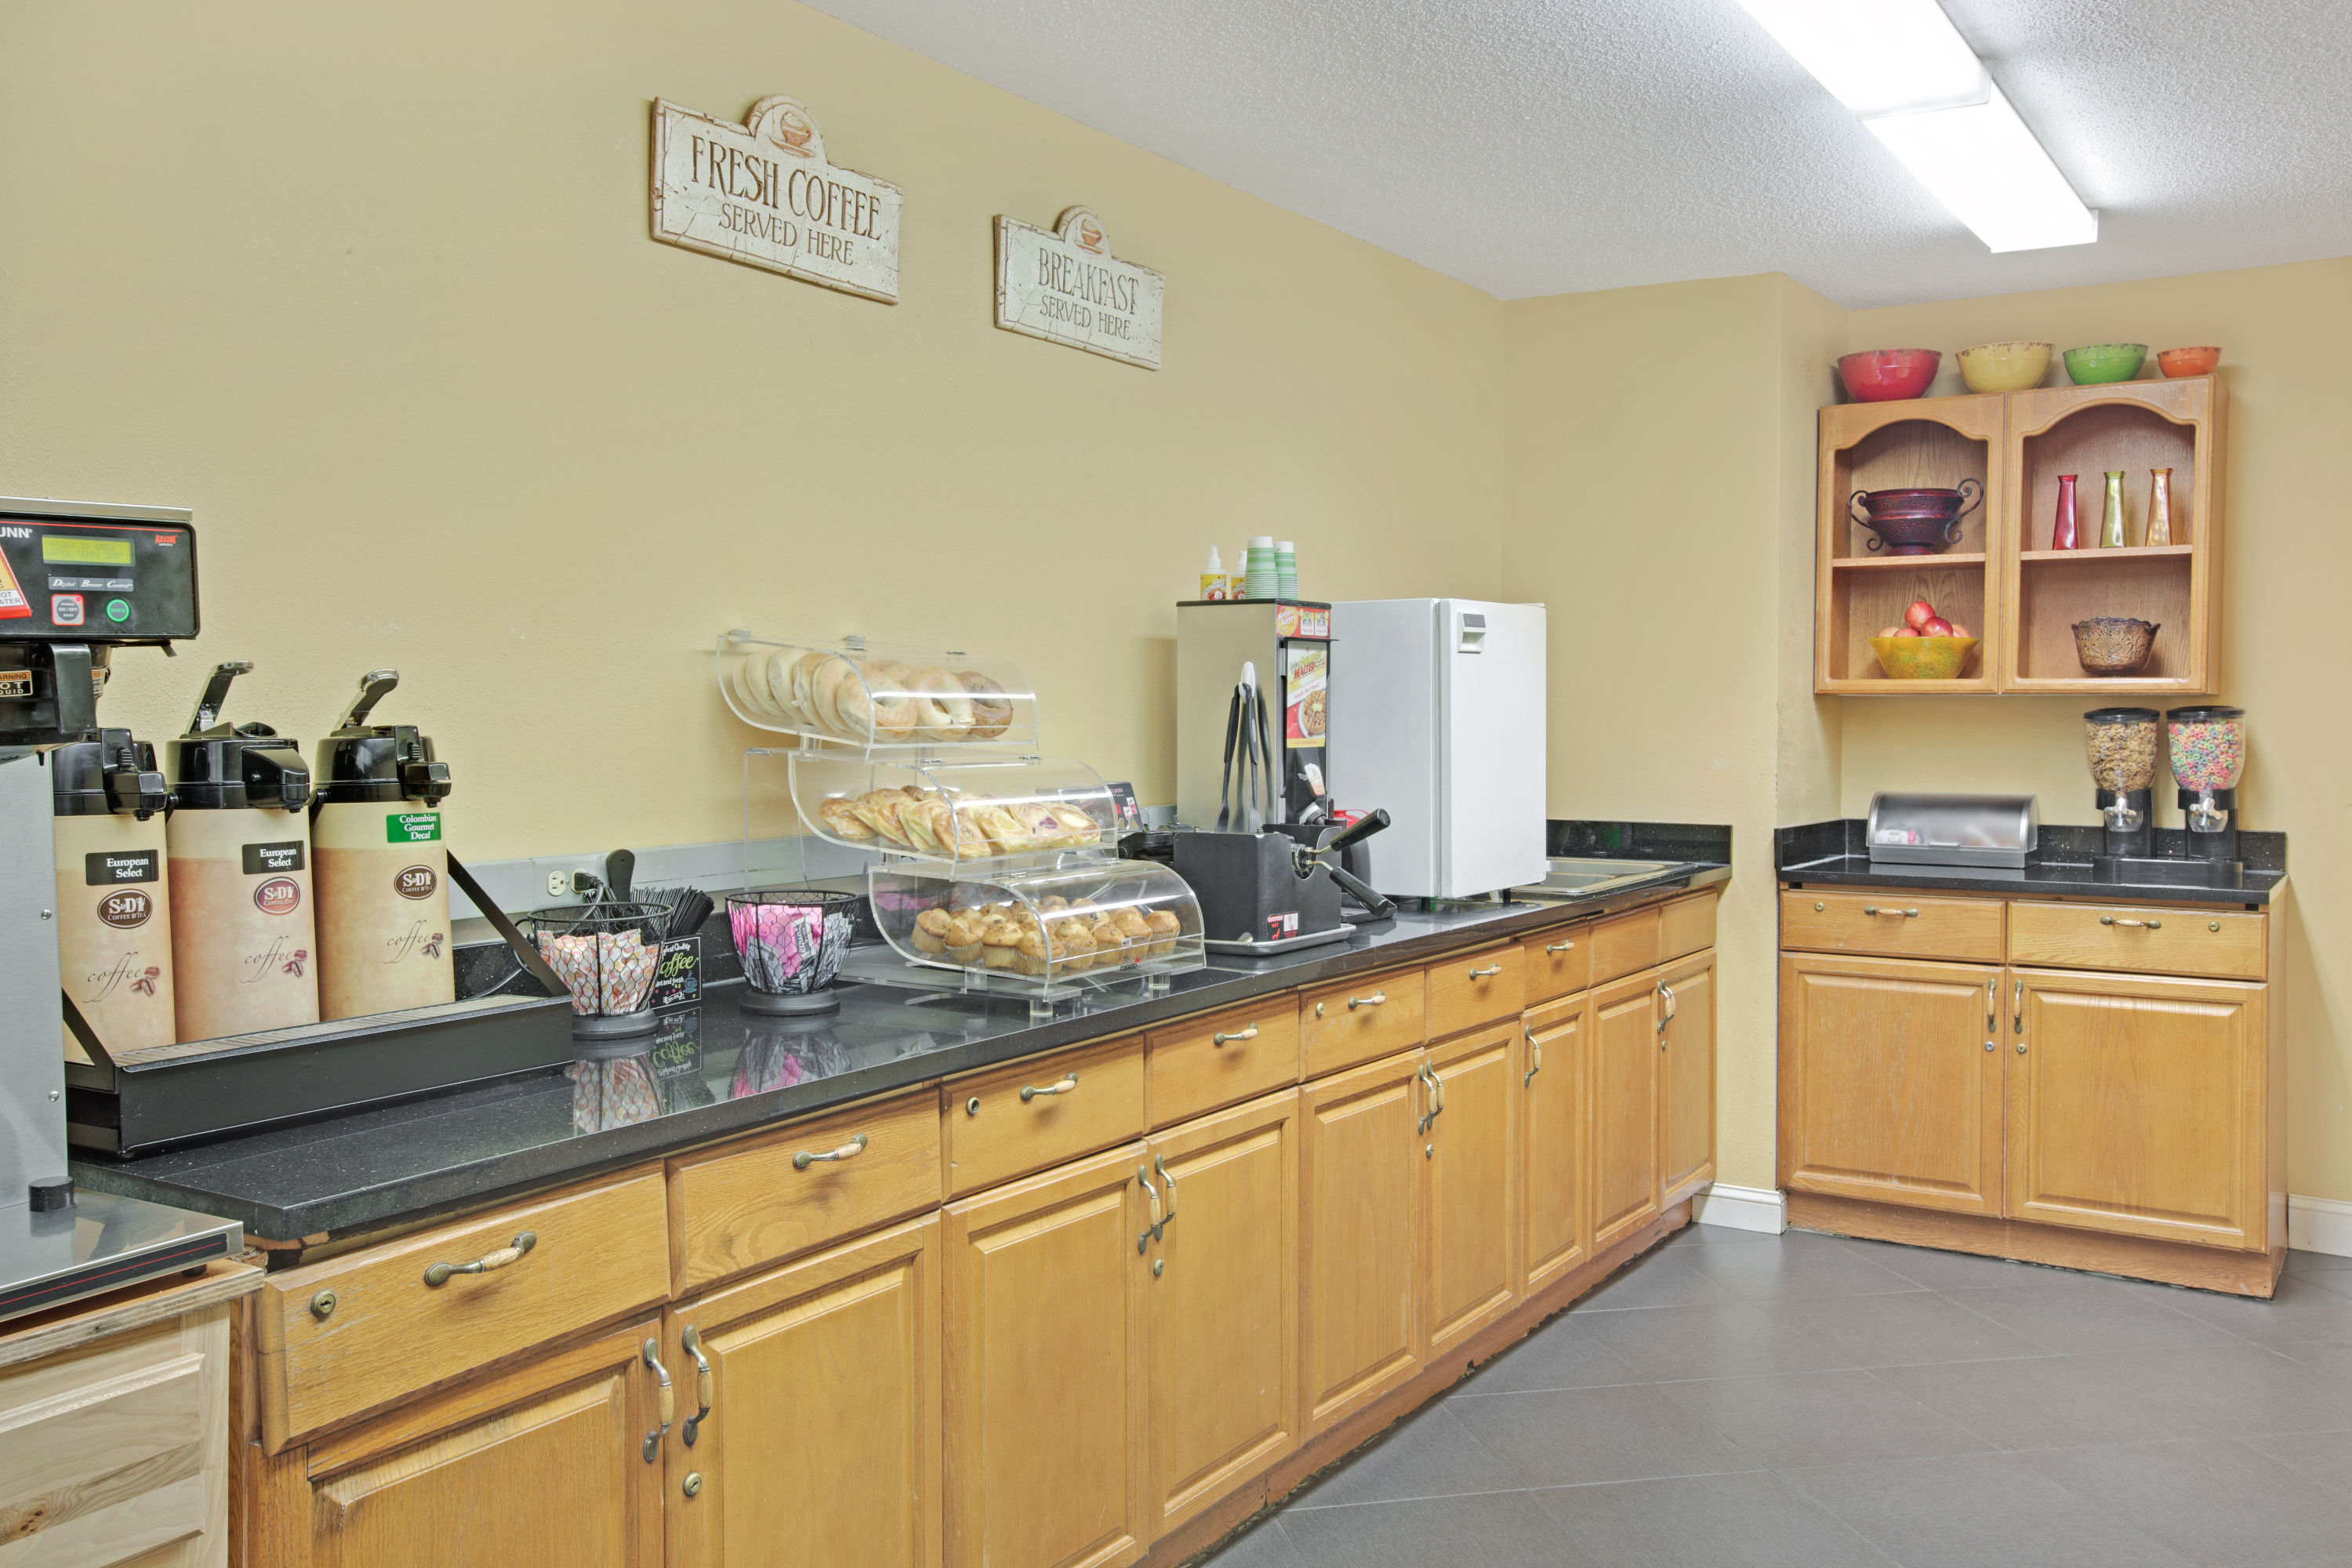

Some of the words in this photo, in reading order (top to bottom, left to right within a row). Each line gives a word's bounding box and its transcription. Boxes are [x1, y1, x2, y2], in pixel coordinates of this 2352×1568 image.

[691, 135, 779, 209] FRESH
[789, 169, 881, 241] COFFEE
[718, 202, 798, 248] SERVED
[807, 228, 855, 267] HERE
[1038, 246, 1139, 315] BREAKFAST
[1040, 295, 1092, 328] SERVED
[1098, 311, 1131, 340] HERE
[1294, 662, 1316, 679] MALTED
[399, 811, 437, 824] Colombian
[404, 822, 435, 833] Gourmet
[410, 831, 431, 840] Decaf
[260, 848, 297, 860] European
[268, 857, 292, 868] Select
[107, 857, 150, 869] European
[116, 868, 143, 878] Select
[402, 872, 425, 887] S&D
[264, 886, 287, 901] S&D
[108, 897, 137, 914] S&D
[383, 920, 430, 964] coffee
[240, 935, 292, 984] coffee
[659, 952, 699, 978] offee
[82, 951, 141, 1004] coffee
